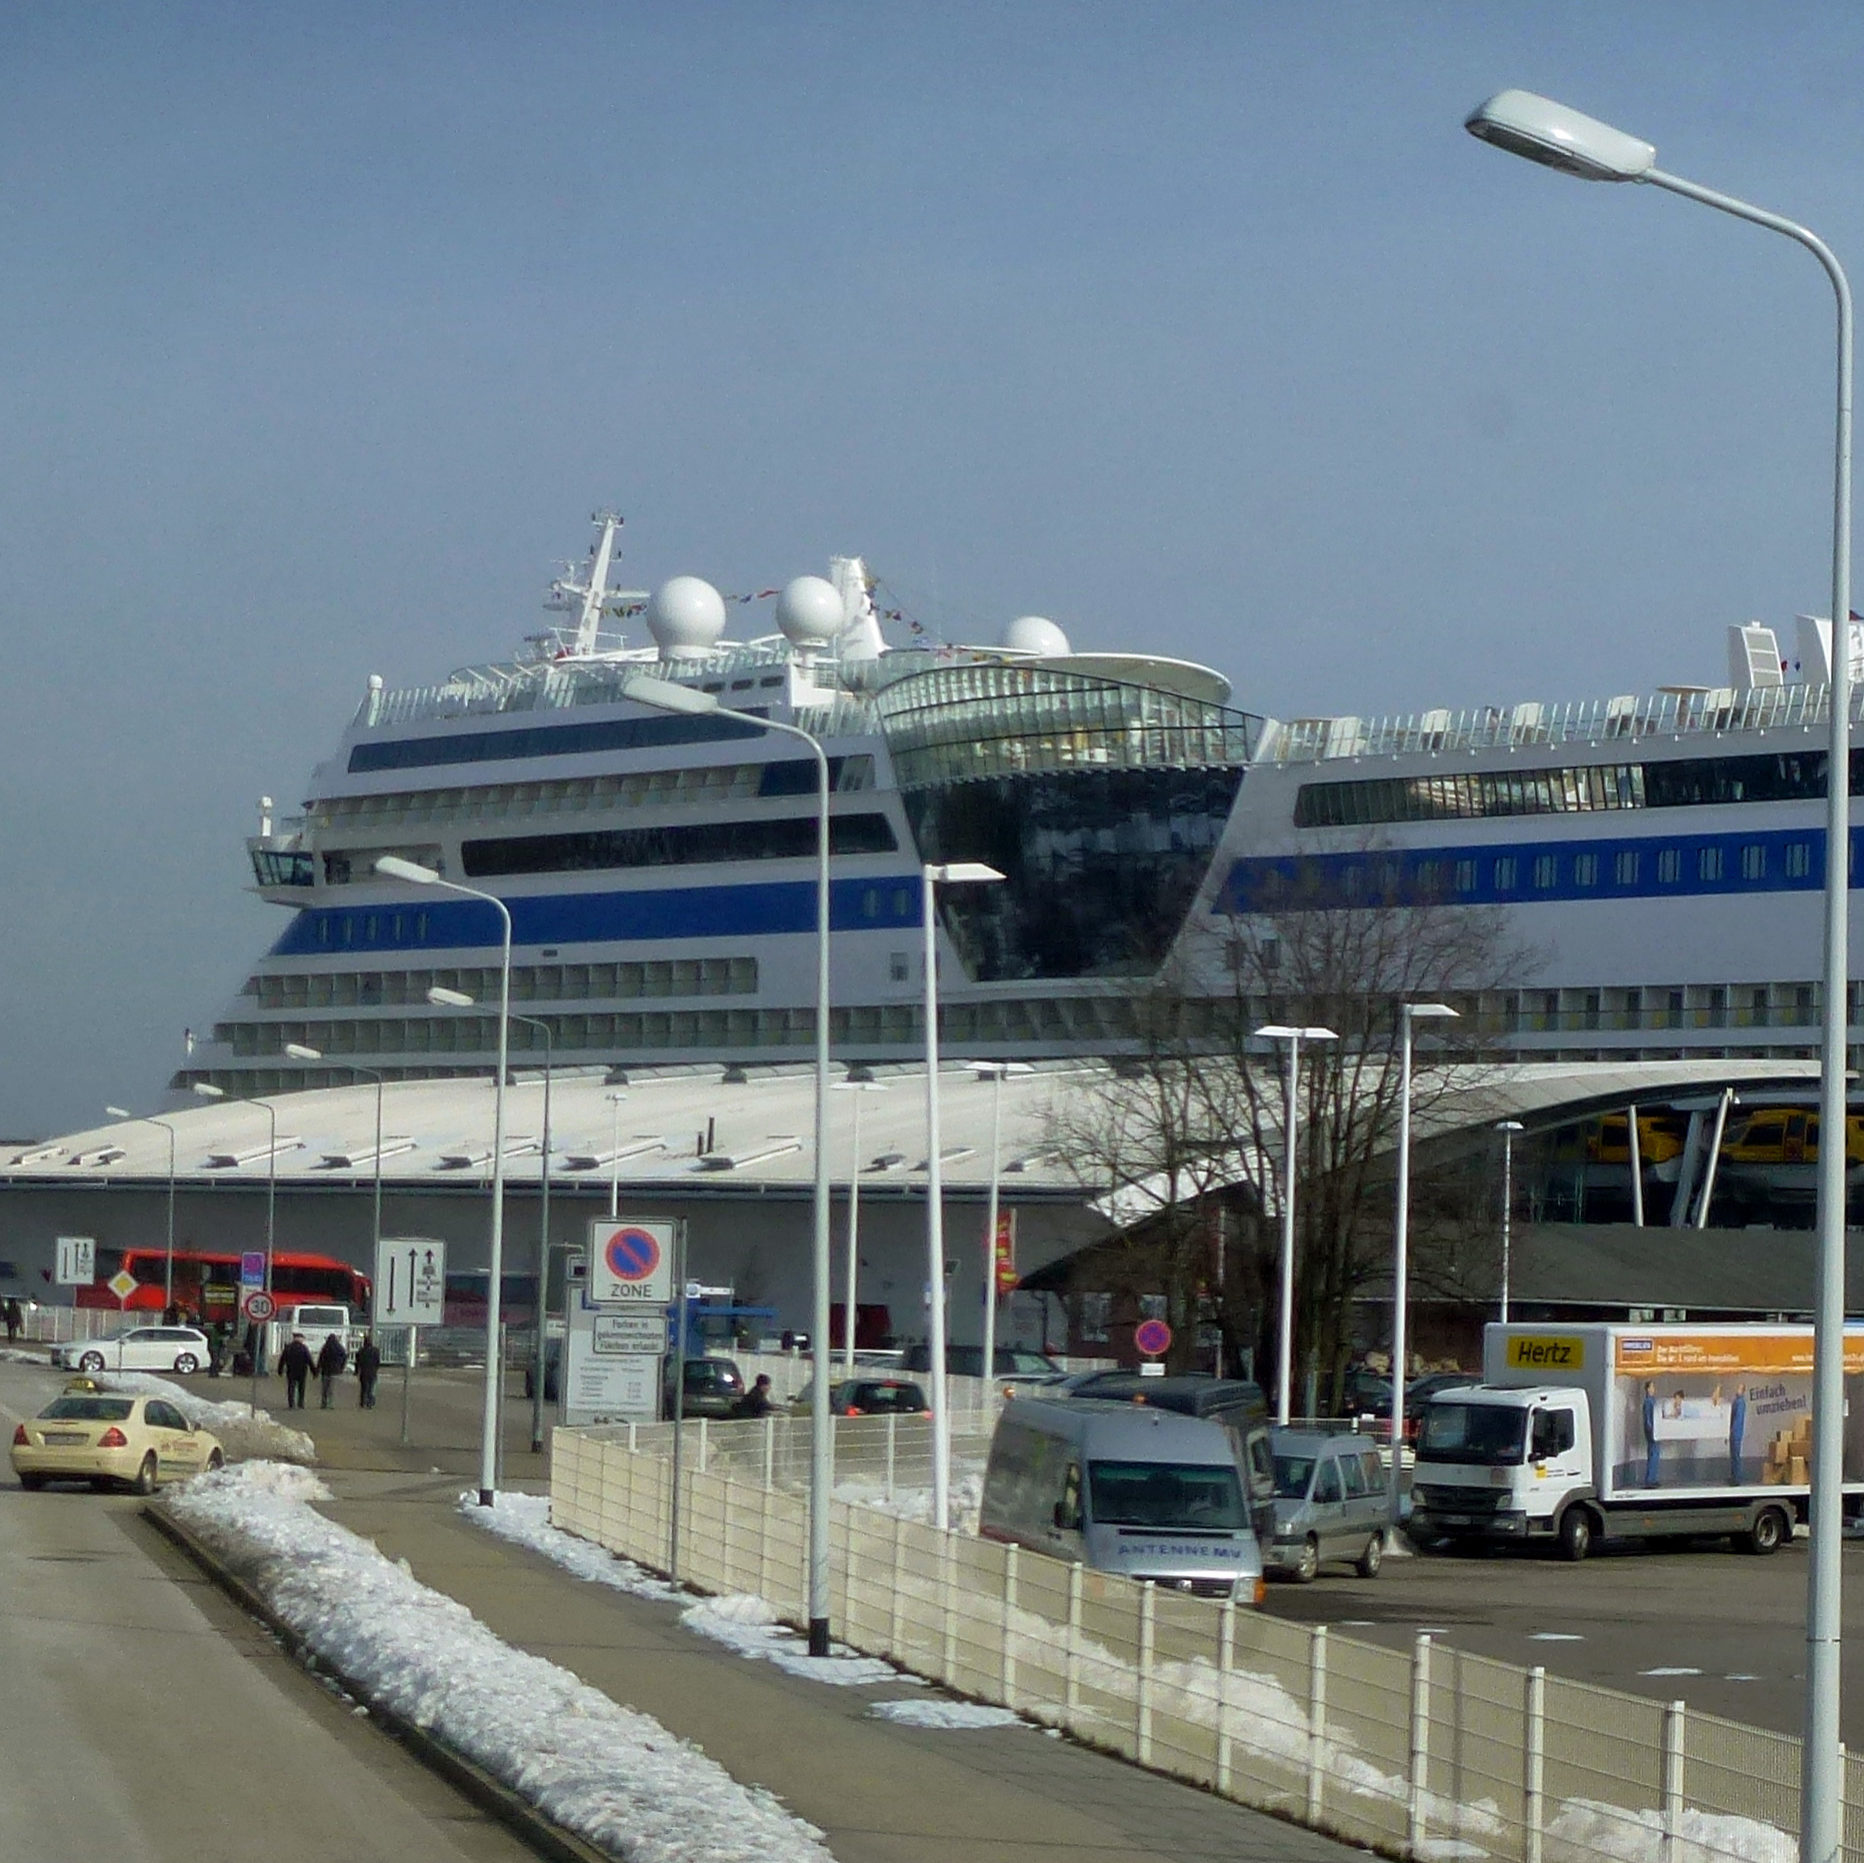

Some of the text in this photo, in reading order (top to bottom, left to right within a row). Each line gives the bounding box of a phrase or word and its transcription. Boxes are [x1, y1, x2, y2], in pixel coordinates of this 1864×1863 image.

[611, 1284, 652, 1298] ZONE
[251, 1300, 269, 1314] 30
[1518, 1341, 1571, 1363] Hertz
[1749, 1384, 1786, 1401] Einfach
[1756, 1395, 1807, 1416] umziehen!
[1117, 1545, 1241, 1558] ANTENNE MV
